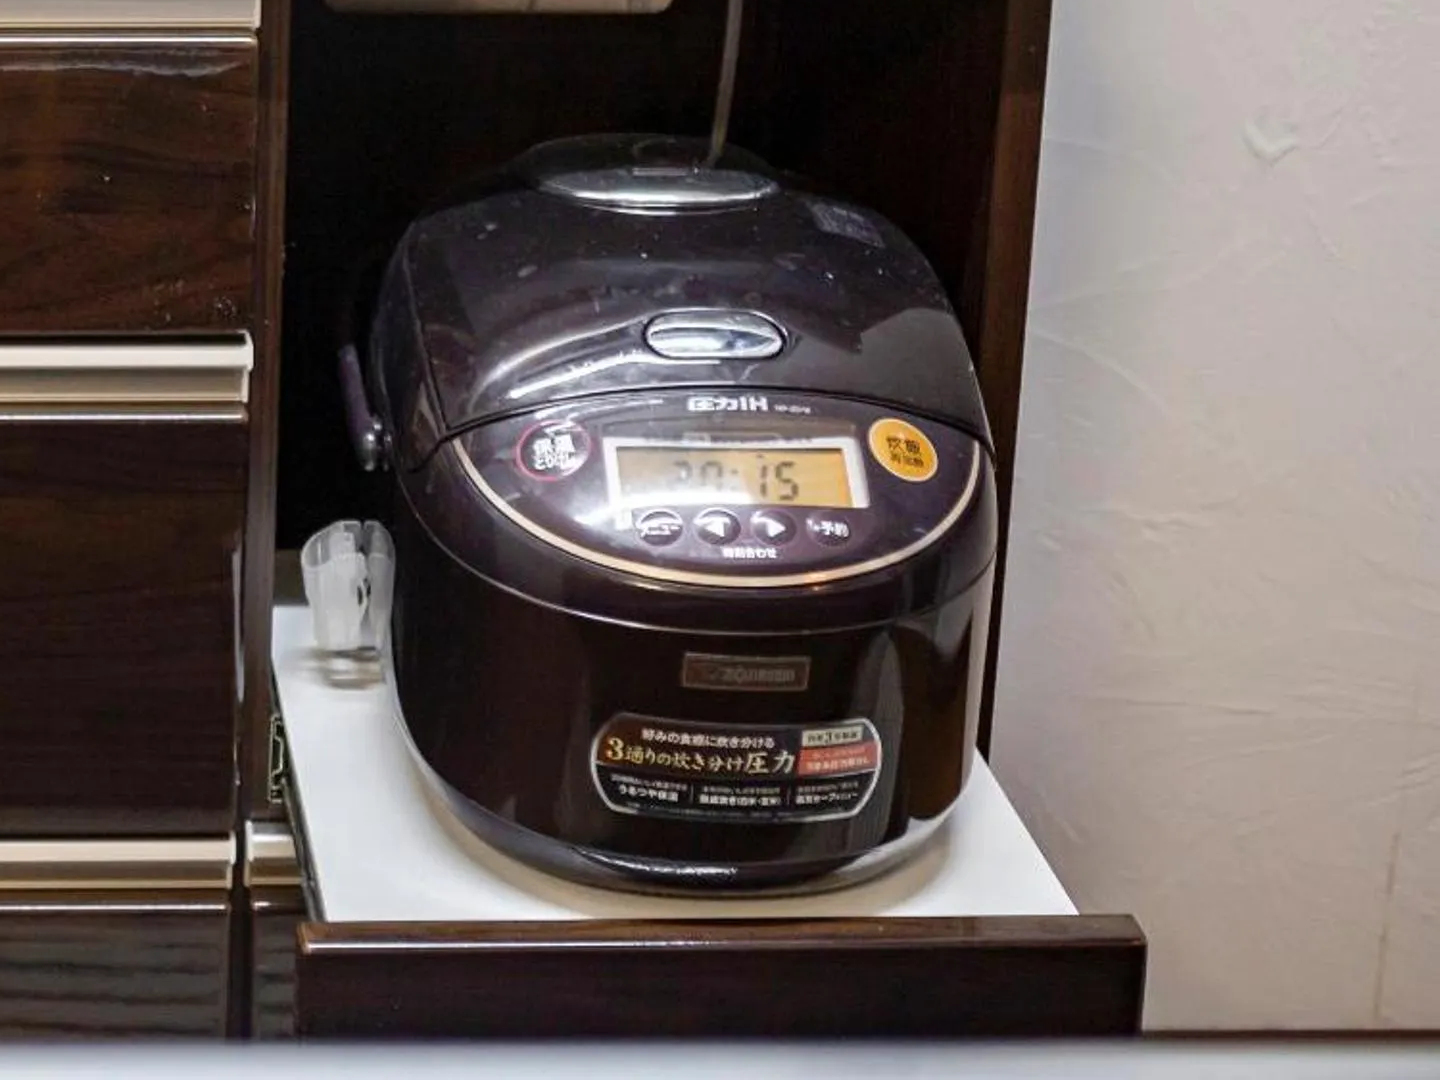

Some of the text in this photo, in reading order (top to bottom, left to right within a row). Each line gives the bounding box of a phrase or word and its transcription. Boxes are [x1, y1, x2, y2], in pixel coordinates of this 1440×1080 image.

[607, 736, 796, 774] 3通りの炊き分け圧力
